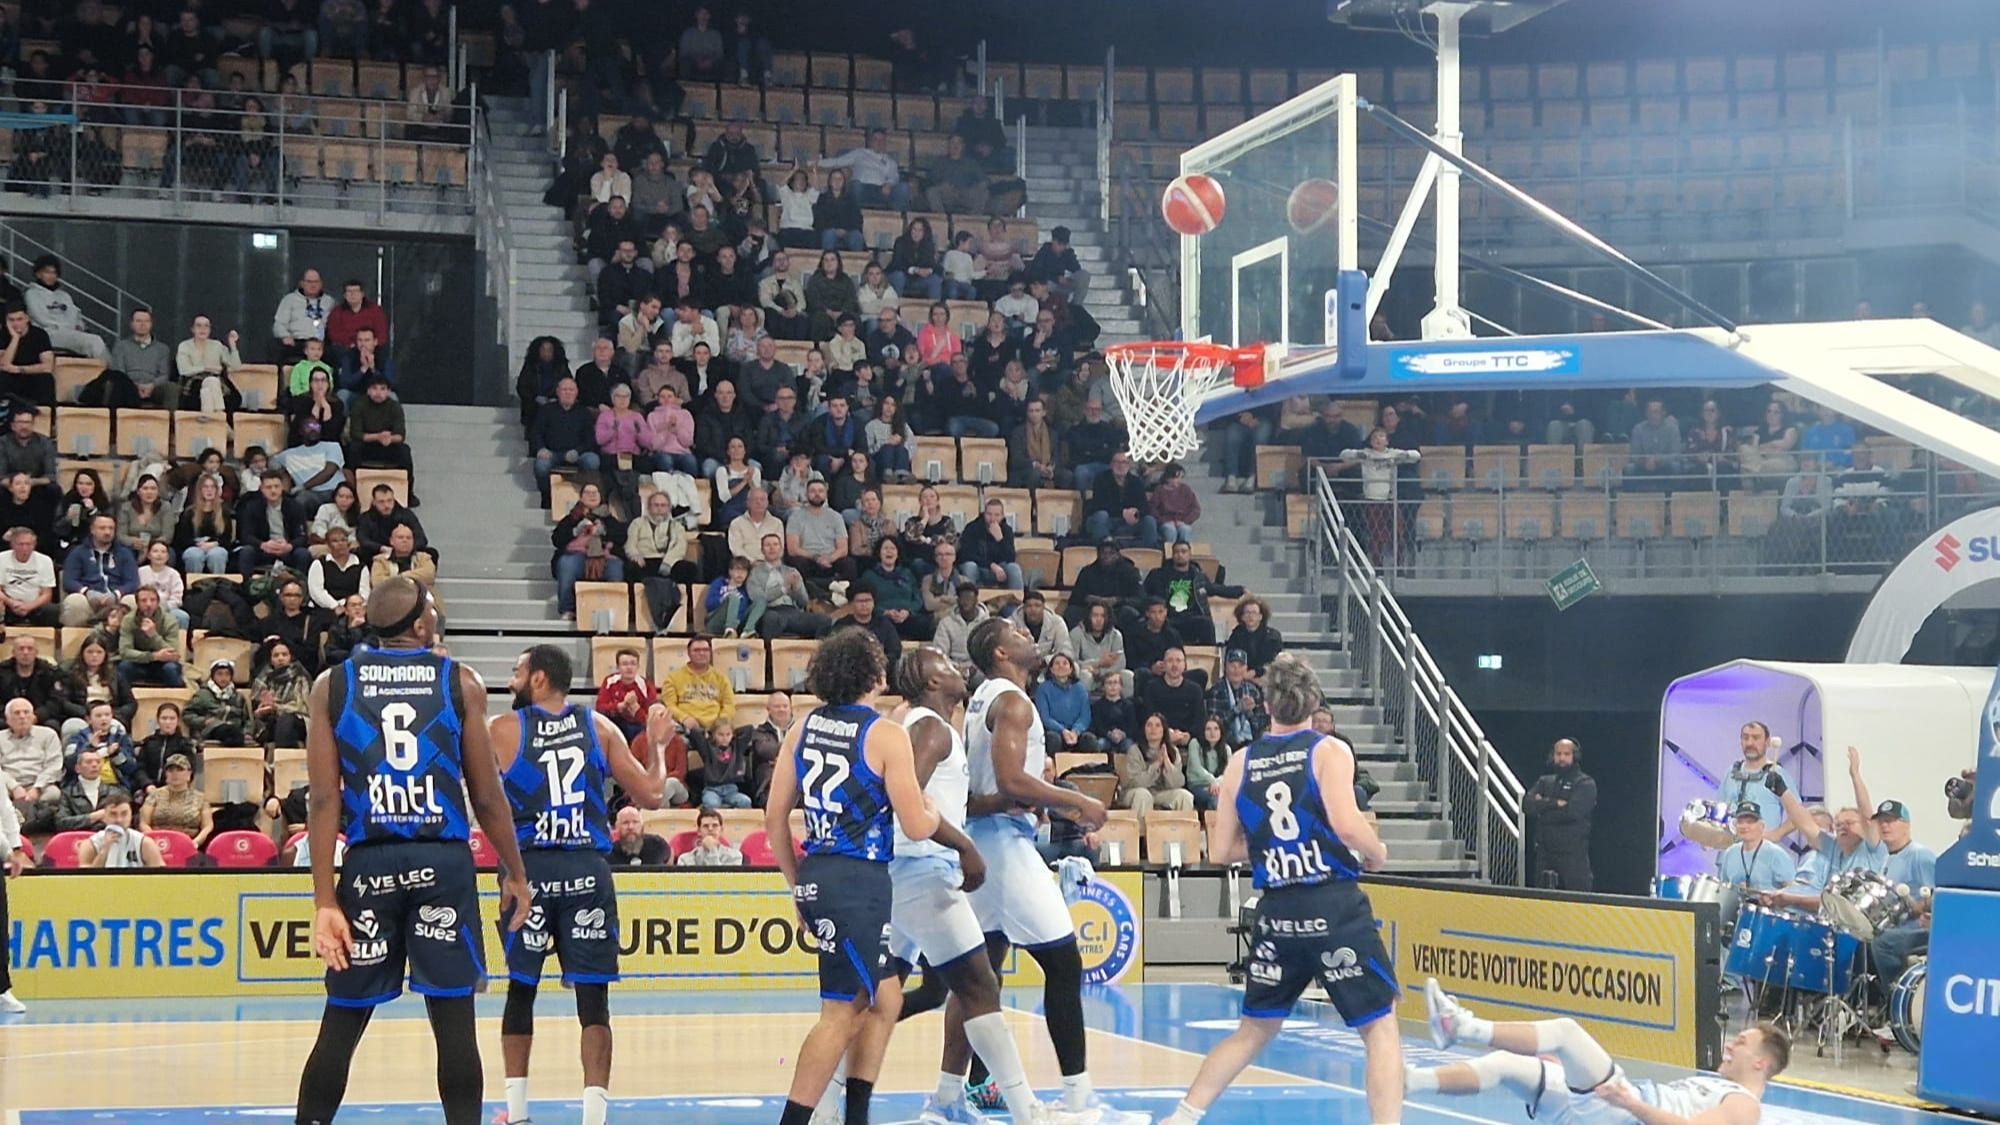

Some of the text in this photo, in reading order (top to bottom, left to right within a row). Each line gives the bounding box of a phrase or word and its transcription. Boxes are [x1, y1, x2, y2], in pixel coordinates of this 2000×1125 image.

[1491, 355, 1529, 367] TTC
[359, 665, 436, 682] SOUMAORO
[381, 702, 419, 771] 6
[537, 746, 585, 807] 12
[802, 748, 850, 814] 22
[1265, 780, 1300, 841] 8
[1968, 851, 2000, 867] Sche
[1412, 944, 1661, 1007] VENTE DE VOITURE D'OCCASION
